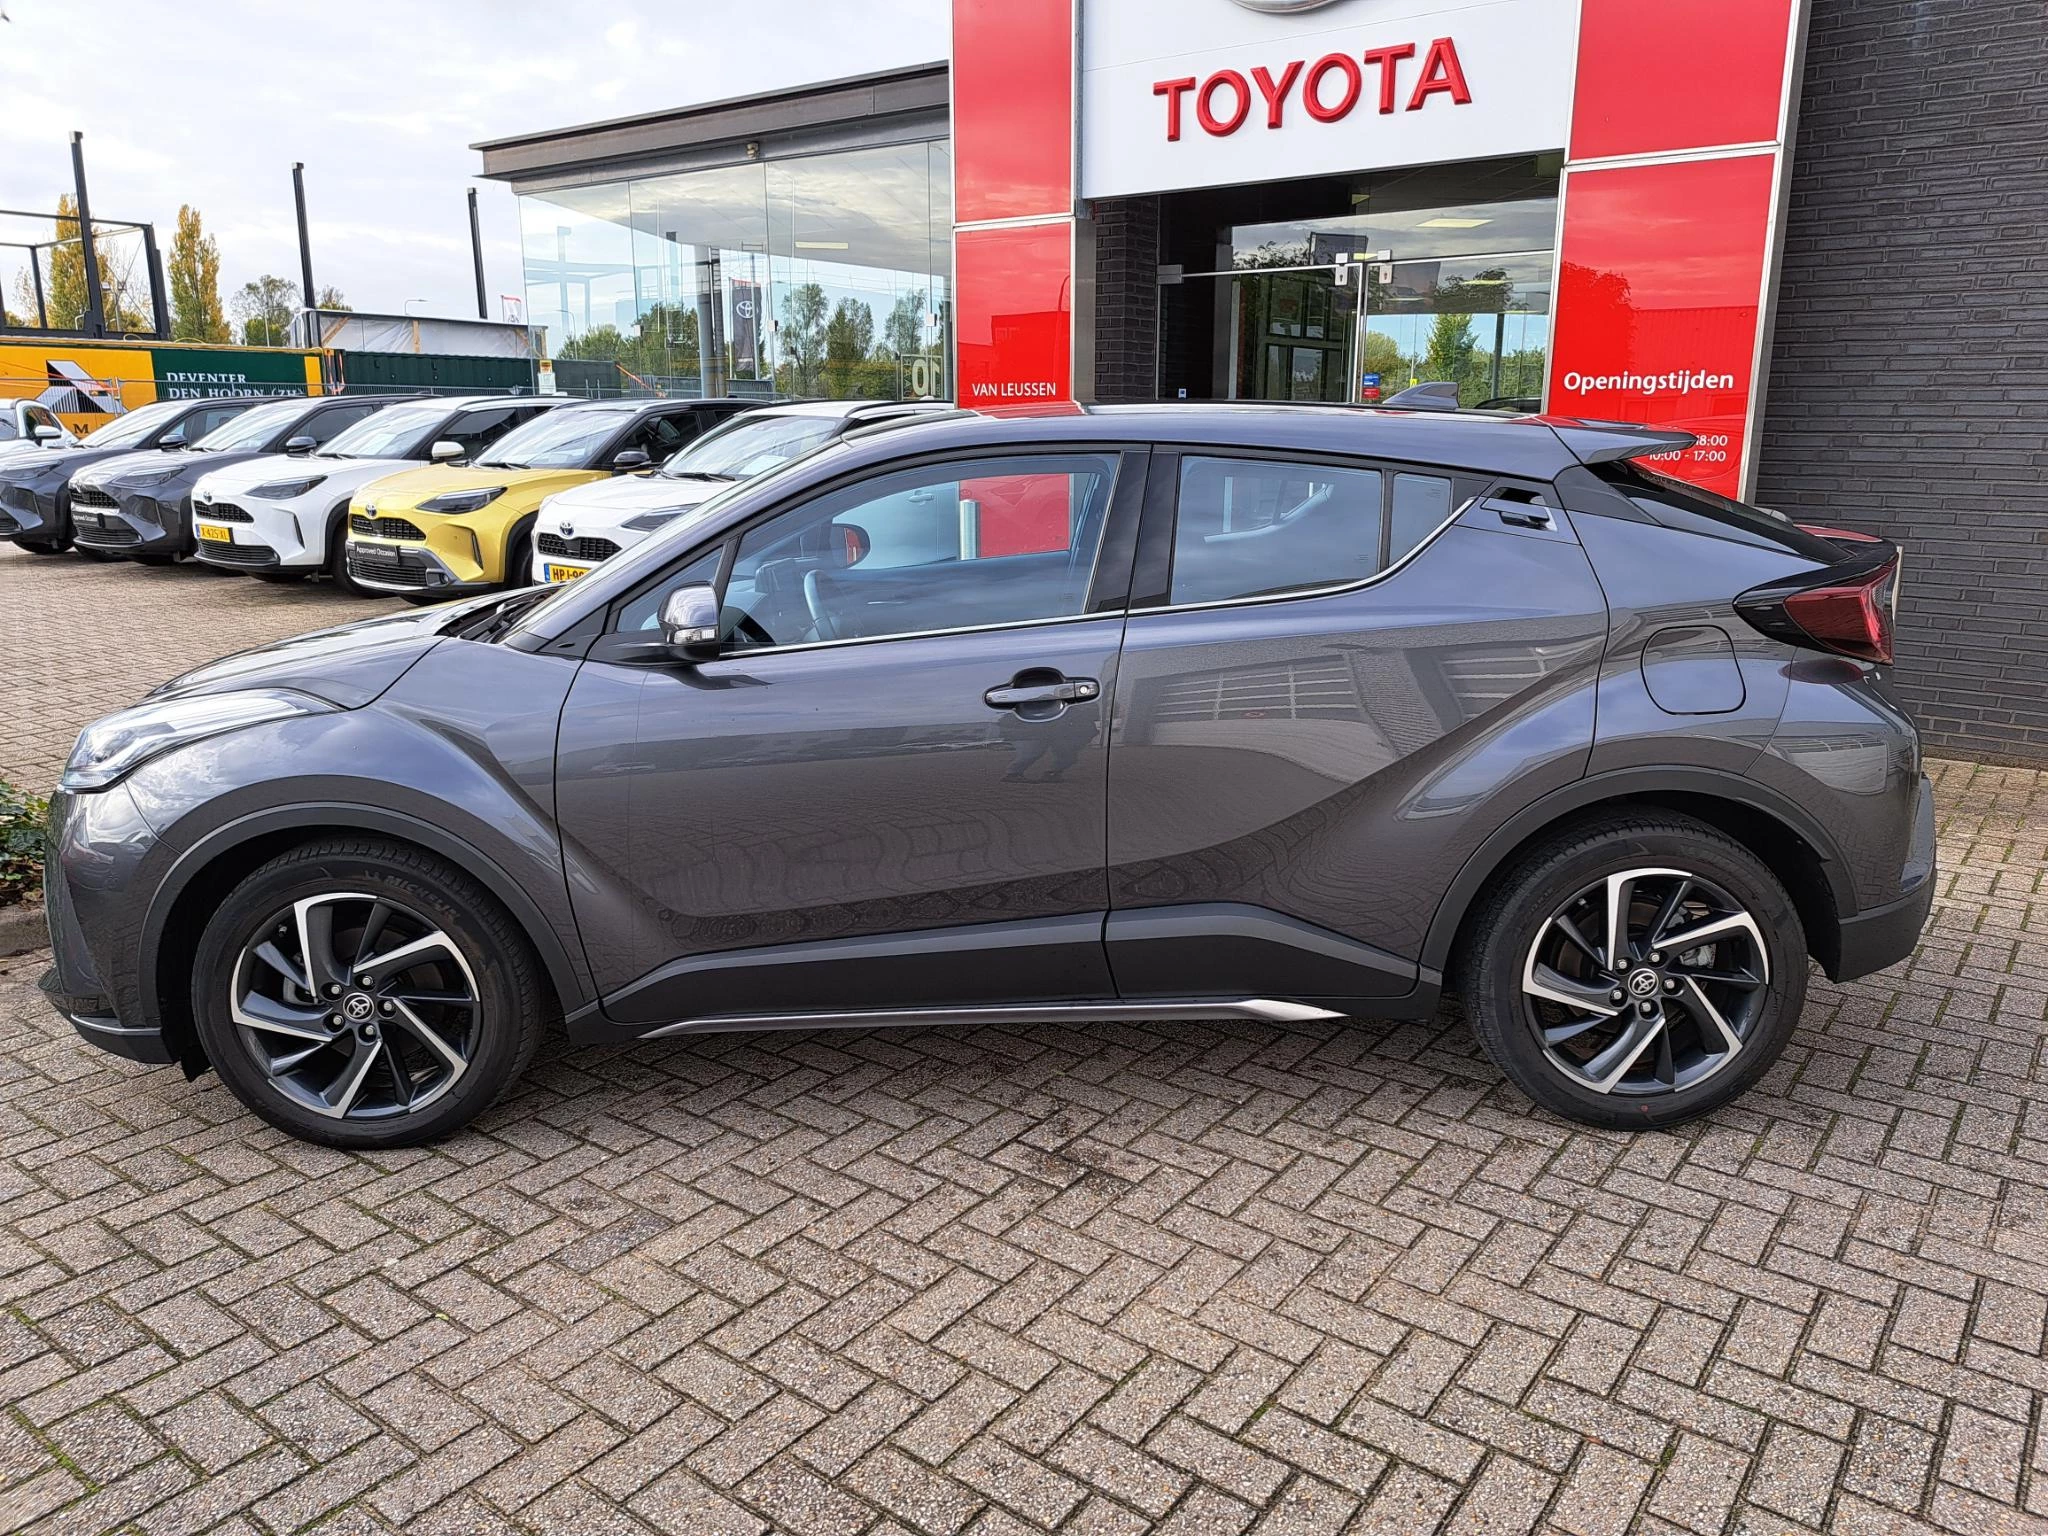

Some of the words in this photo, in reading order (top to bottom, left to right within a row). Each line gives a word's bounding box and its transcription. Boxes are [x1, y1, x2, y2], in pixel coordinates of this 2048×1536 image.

[1153, 37, 1472, 142] TOYOTA
[166, 372, 246, 383] DEVENTER
[1563, 369, 1734, 395] Openingstijden
[168, 388, 200, 399] DEN
[208, 388, 263, 397] HOORN
[971, 383, 998, 396] VAN
[1001, 382, 1056, 396] LEUSSEN
[1693, 450, 1727, 462] 17:00
[356, 545, 377, 555] Approved
[377, 547, 396, 557] Occasion
[384, 874, 461, 921] MICHELIN
